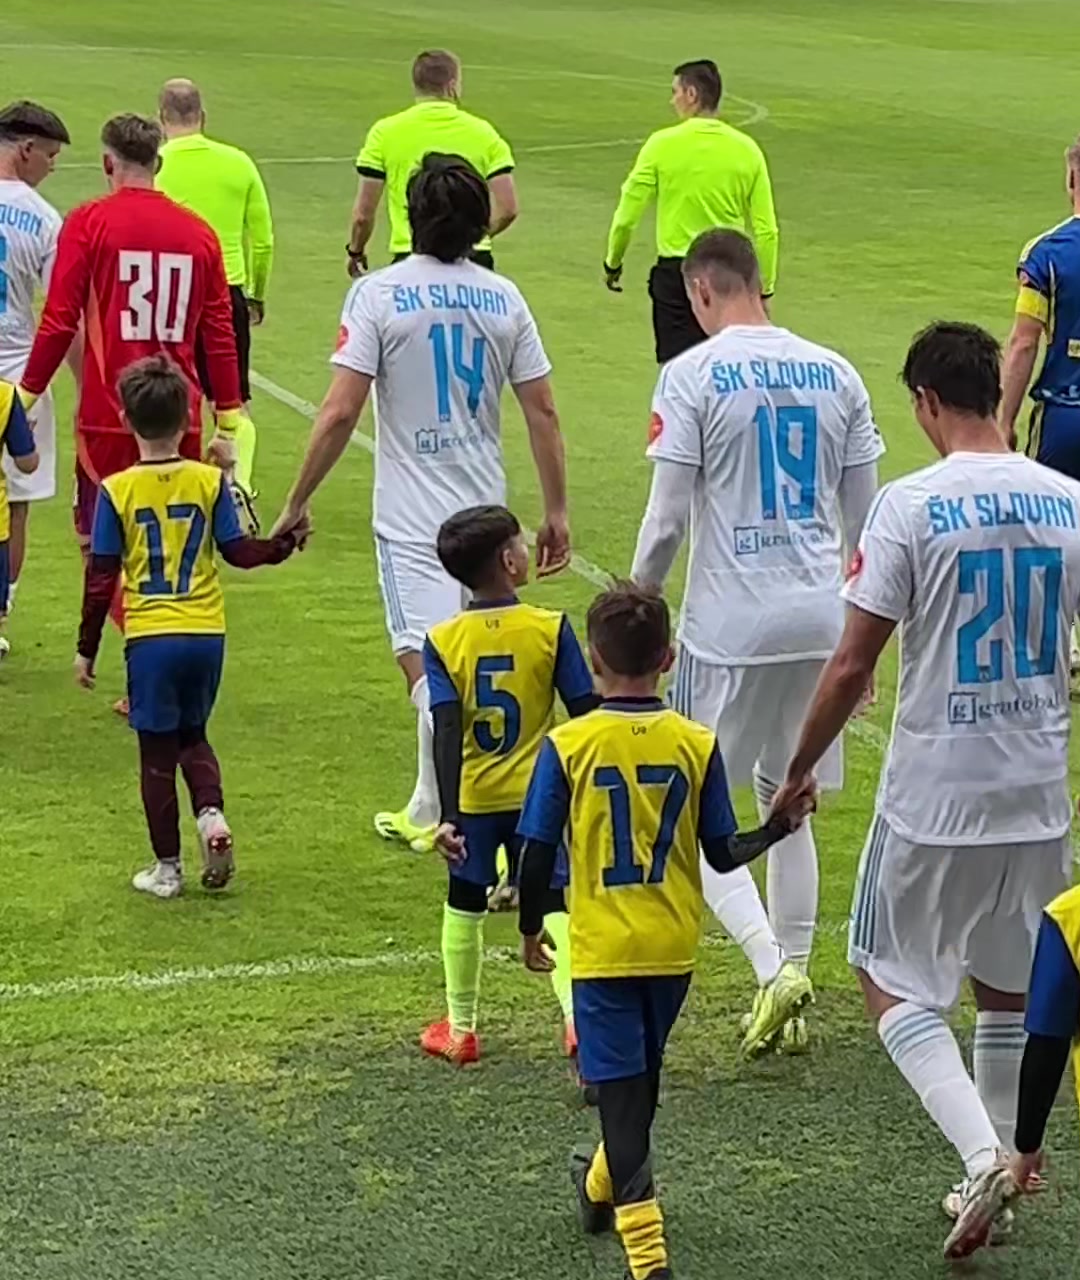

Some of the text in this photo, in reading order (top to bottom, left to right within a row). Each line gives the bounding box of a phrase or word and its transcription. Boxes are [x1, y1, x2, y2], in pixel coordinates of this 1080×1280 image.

[119, 249, 193, 342] 30
[428, 323, 487, 423] 14
[711, 361, 748, 395] ŠK
[753, 405, 817, 520] 19
[135, 503, 206, 597] 17
[928, 492, 1077, 535] ŠK SLOVAN
[957, 546, 1063, 684] 20
[473, 654, 521, 755] 5
[593, 764, 689, 887] 17
